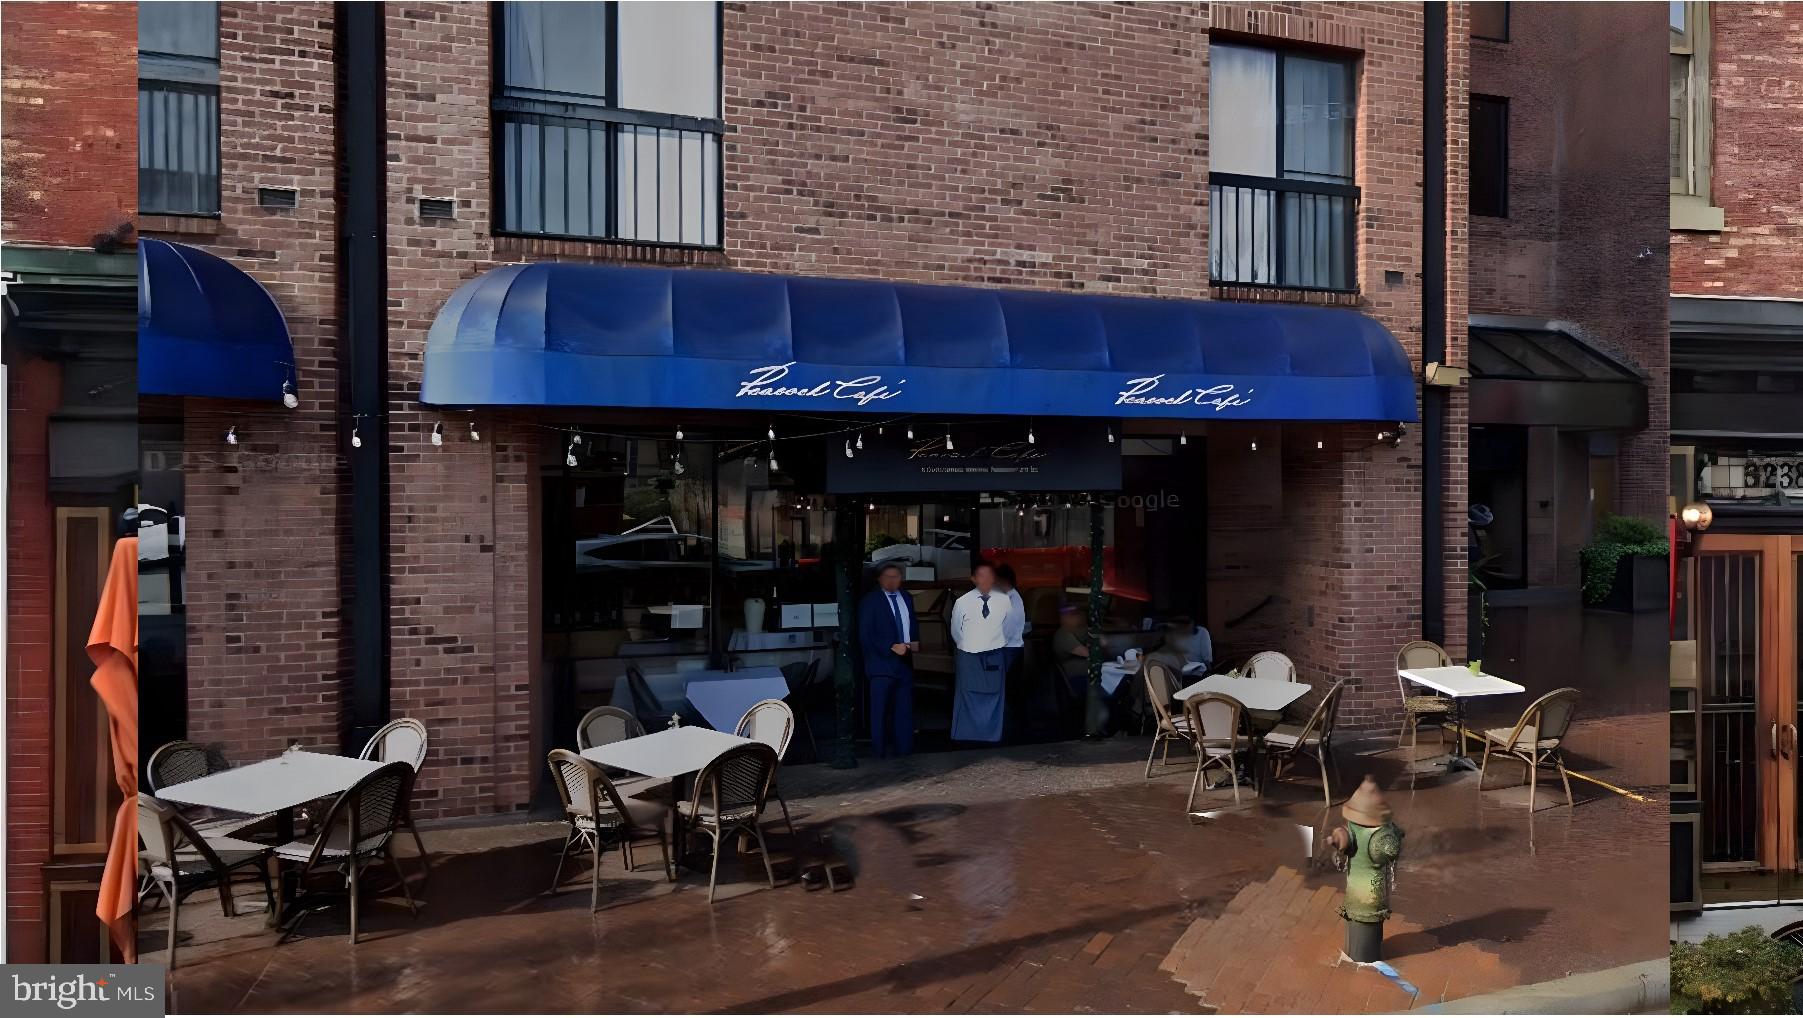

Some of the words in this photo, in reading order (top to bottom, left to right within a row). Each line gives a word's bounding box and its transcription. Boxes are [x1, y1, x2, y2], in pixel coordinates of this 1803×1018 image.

[735, 361, 831, 398] Peacock
[833, 375, 907, 406] Café
[1114, 373, 1194, 405] Peacock
